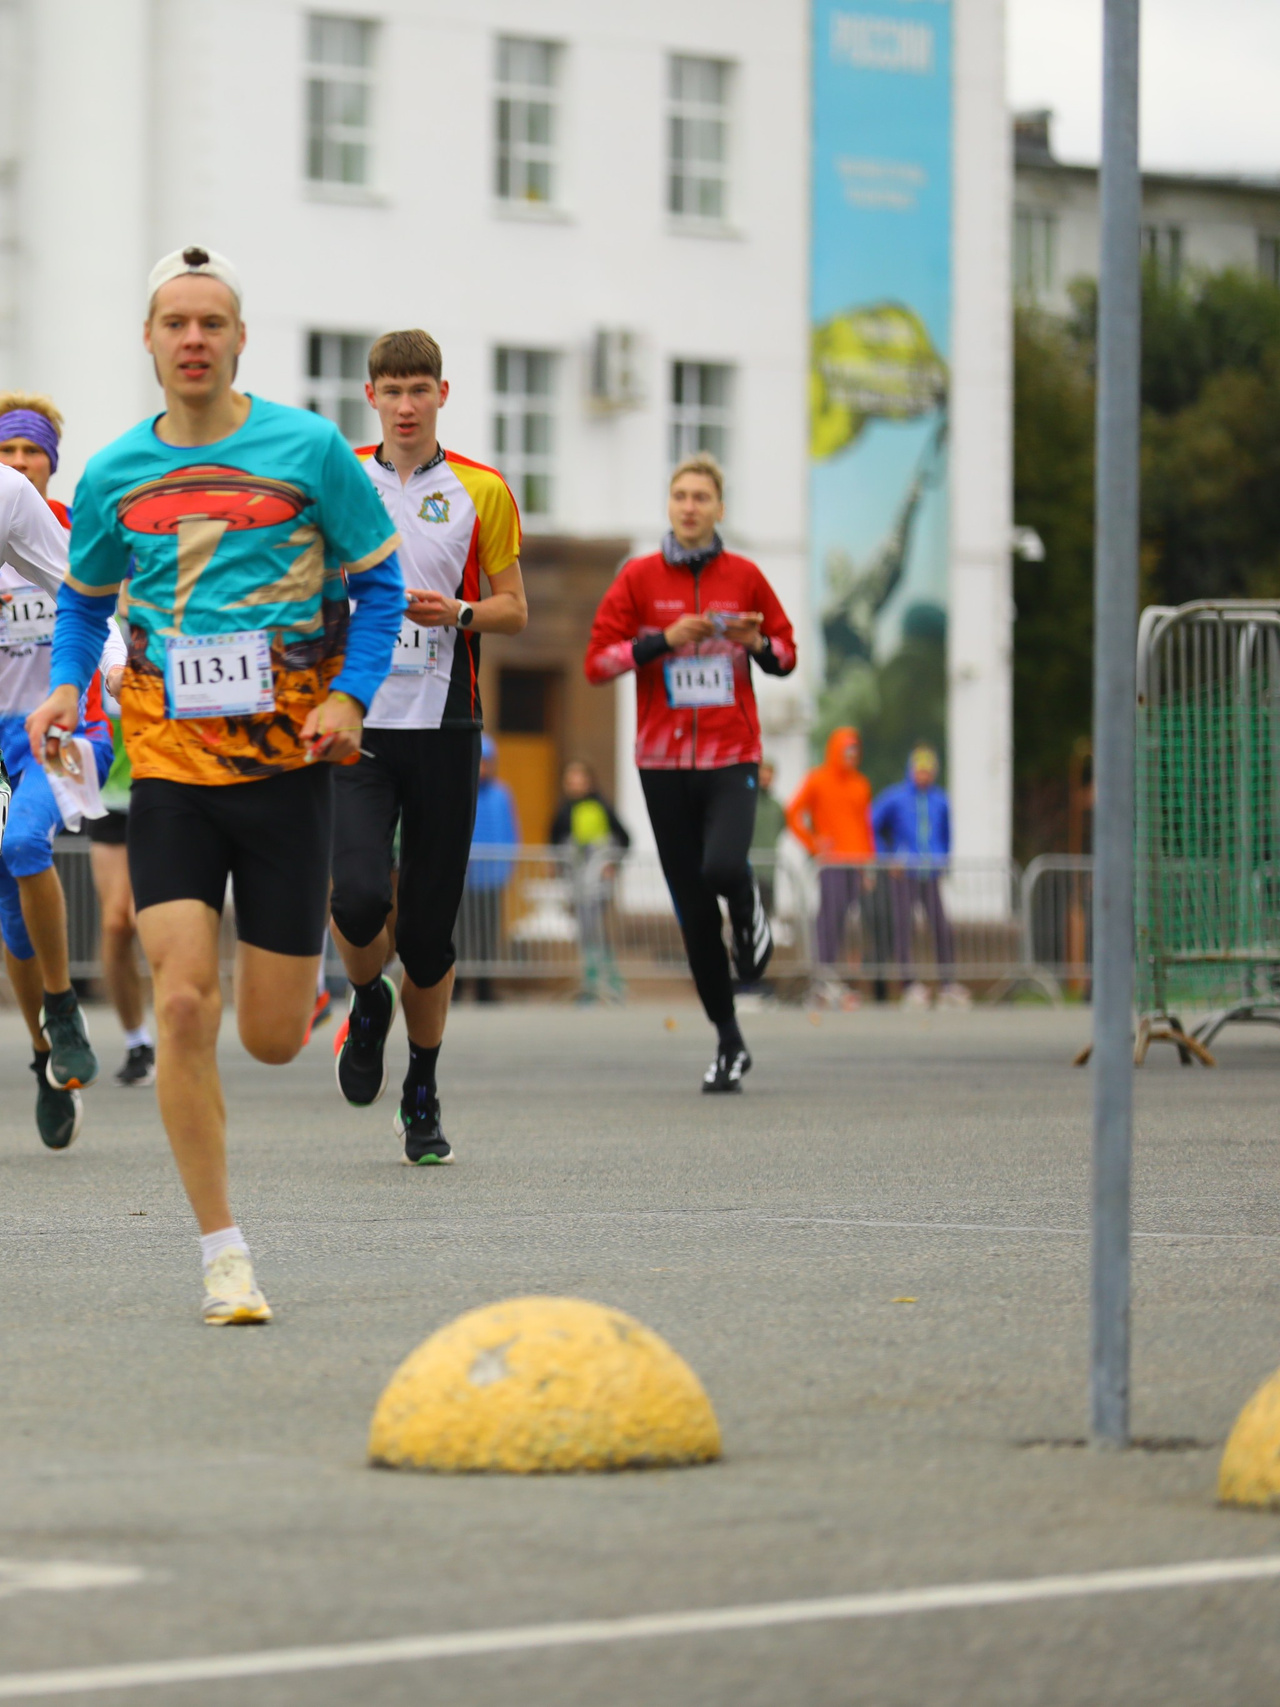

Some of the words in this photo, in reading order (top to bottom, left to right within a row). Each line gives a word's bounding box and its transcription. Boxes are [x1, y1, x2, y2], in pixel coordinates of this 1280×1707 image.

[11, 600, 55, 622] 112.
[177, 654, 252, 685] 113.1
[676, 669, 721, 688] 114.1
